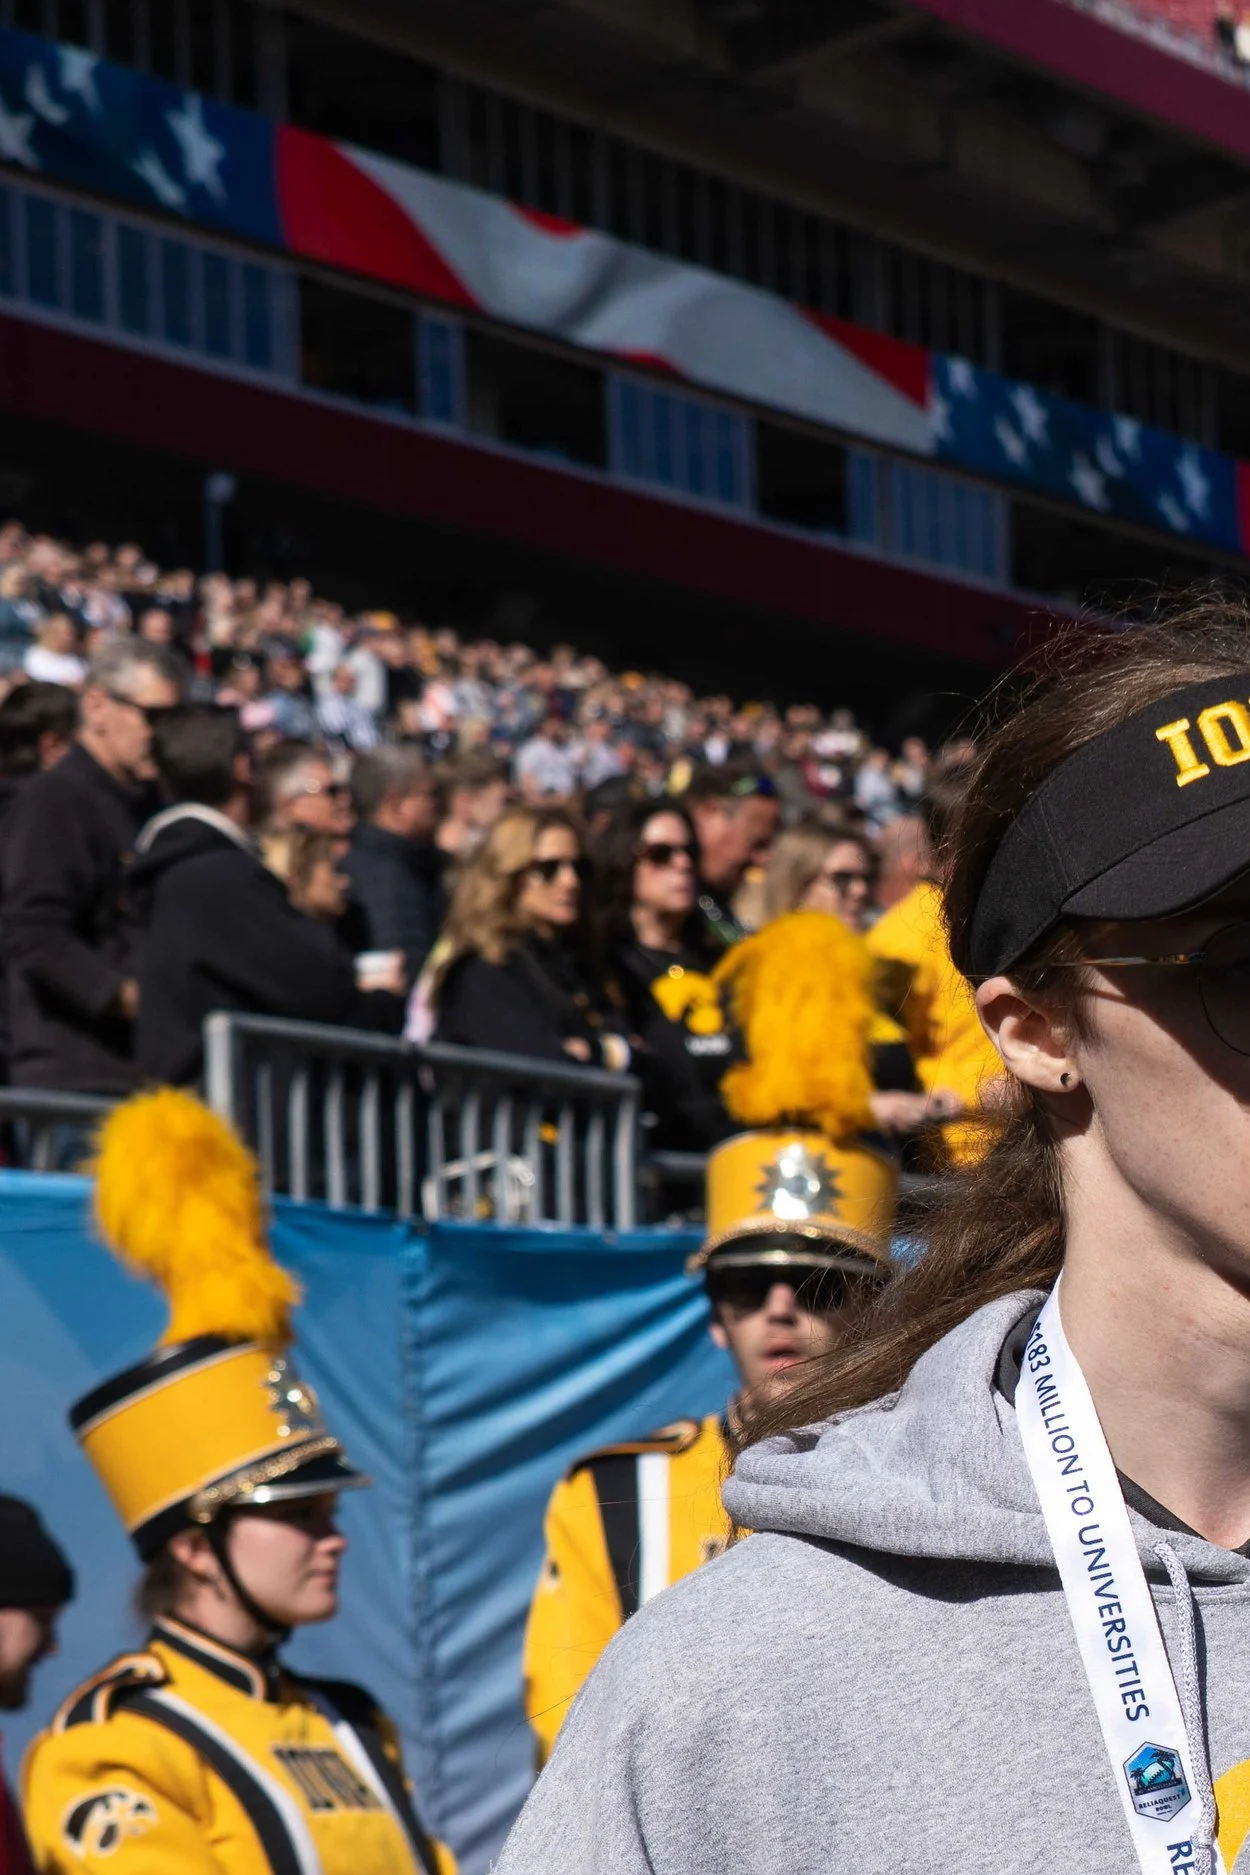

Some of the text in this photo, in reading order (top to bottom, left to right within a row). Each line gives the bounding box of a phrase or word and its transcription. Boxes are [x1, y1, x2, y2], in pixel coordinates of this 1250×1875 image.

[1034, 1373, 1083, 1476] MILLION
[1066, 1480, 1095, 1516] TO
[1078, 1523, 1150, 1722] UNIVERSITIES
[1138, 1793, 1181, 1809] RELIAQUEST
